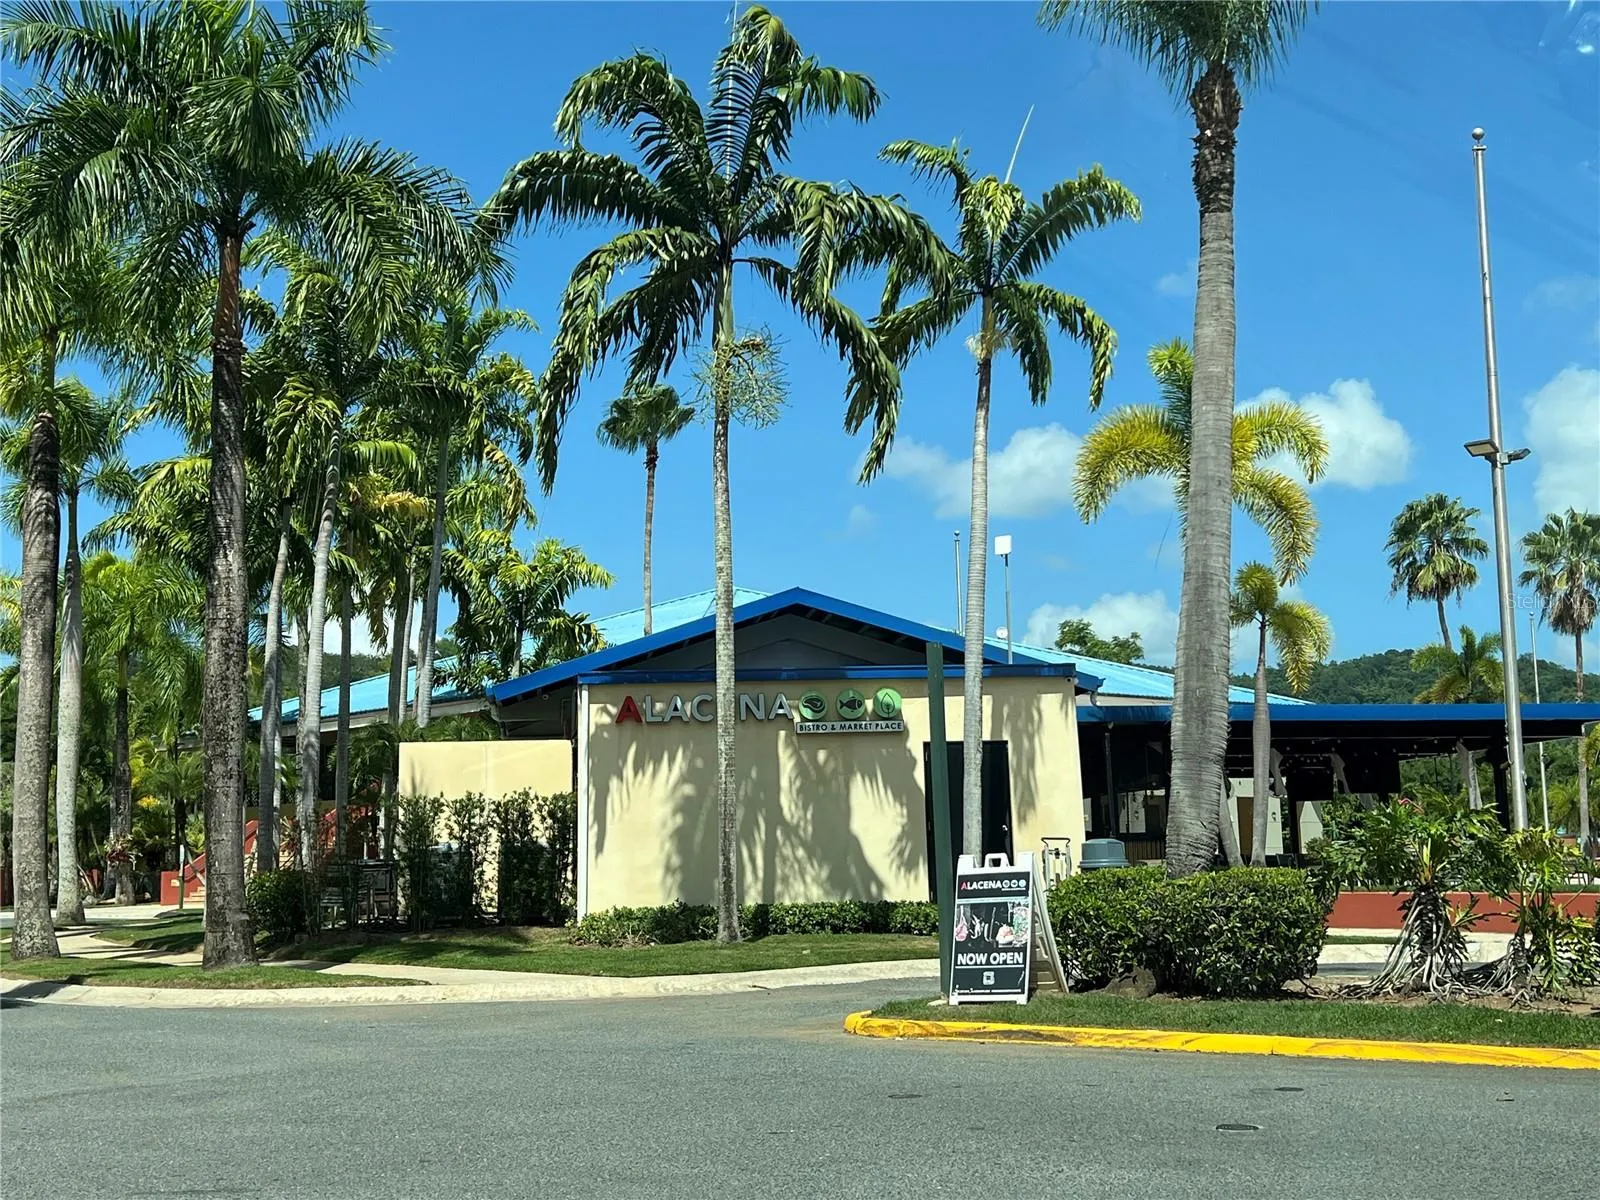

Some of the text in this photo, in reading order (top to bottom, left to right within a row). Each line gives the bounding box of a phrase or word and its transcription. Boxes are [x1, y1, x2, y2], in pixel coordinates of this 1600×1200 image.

[616, 692, 794, 723] ALACNA
[799, 724, 827, 732] BISTRO
[839, 723, 873, 731] MARKET
[875, 722, 902, 730] PLACE
[961, 880, 1002, 890] ALACENA
[957, 951, 1023, 965] NOW OPEN
